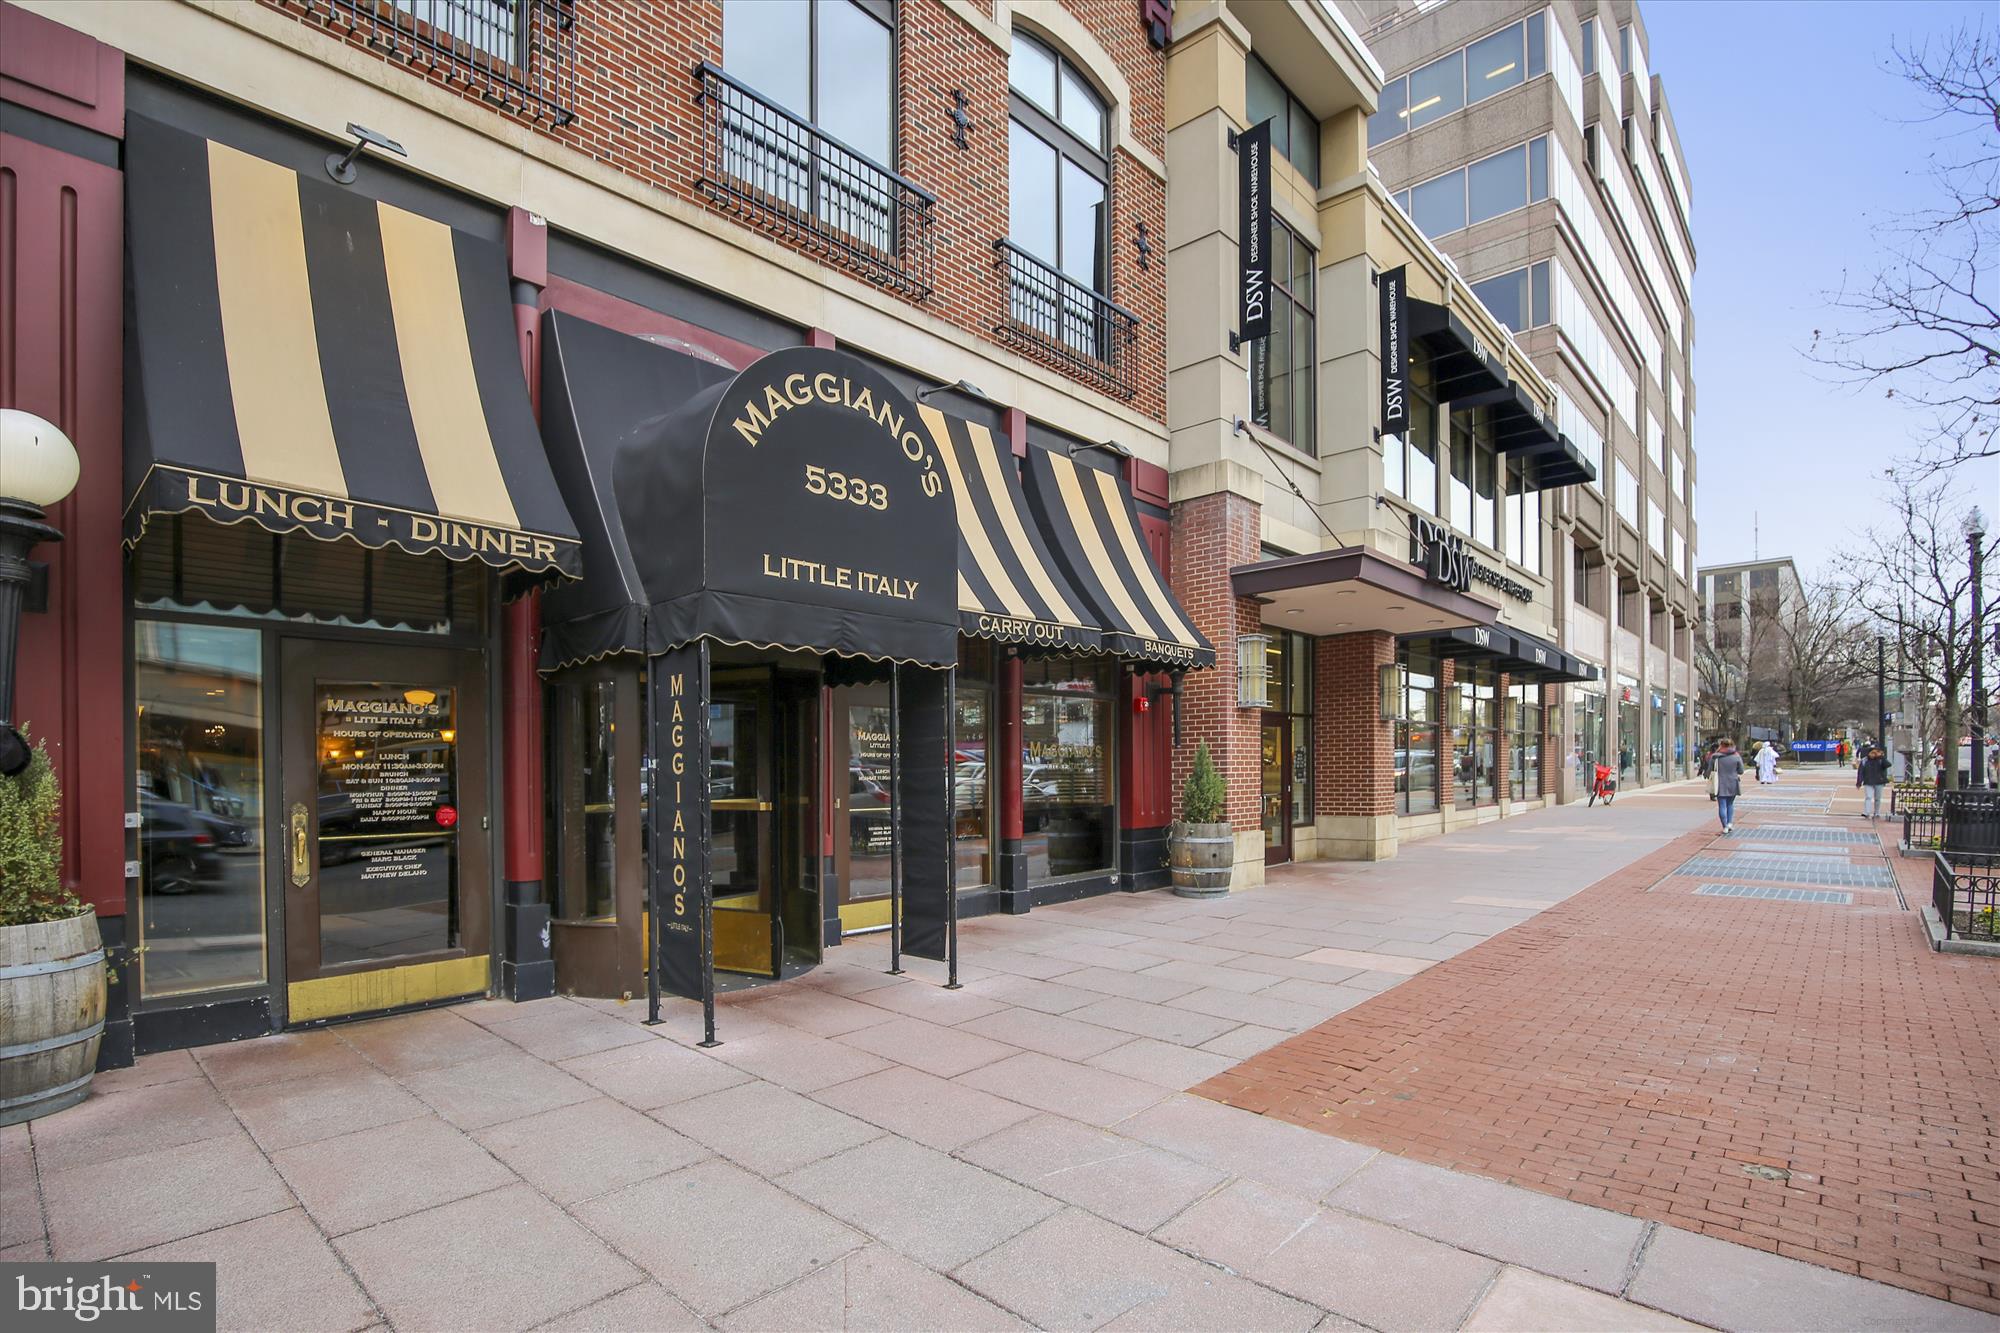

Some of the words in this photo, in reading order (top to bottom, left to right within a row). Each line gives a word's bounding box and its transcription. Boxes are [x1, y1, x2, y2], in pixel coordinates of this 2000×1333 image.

[1250, 140, 1259, 193] WAREHOUSE
[1250, 193, 1258, 219] SHOE
[1250, 220, 1258, 263] DESIGNER
[1246, 269, 1264, 323] DSW
[1389, 320, 1398, 340] SHOE
[1390, 341, 1398, 374] DESIGNER
[1473, 336, 1489, 364] DSW
[1387, 377, 1403, 421] DSW
[1532, 403, 1545, 425] DSW
[732, 372, 944, 498] MAGGIANO'S
[805, 464, 889, 511] 5333
[186, 474, 355, 529] LUNCH
[410, 515, 558, 562] DINNER
[763, 553, 852, 590] LITTLE
[857, 571, 919, 600] ITALY
[1437, 539, 1475, 591] DSW
[979, 615, 1032, 636] CARRY
[1034, 623, 1065, 640] OUT
[1474, 627, 1490, 647] DSW
[1144, 641, 1195, 660] BANQUETS
[1535, 648, 1547, 665] DSW
[327, 698, 440, 716] MAGGIANO'S
[354, 716, 388, 724] LITTLE
[389, 717, 417, 725] ITALY
[333, 730, 367, 738] HOURS
[382, 731, 435, 739] OPERATION
[857, 731, 891, 741] MAGGIA
[379, 753, 410, 761] LUNCH
[670, 673, 687, 917] MAGGIANO'S
